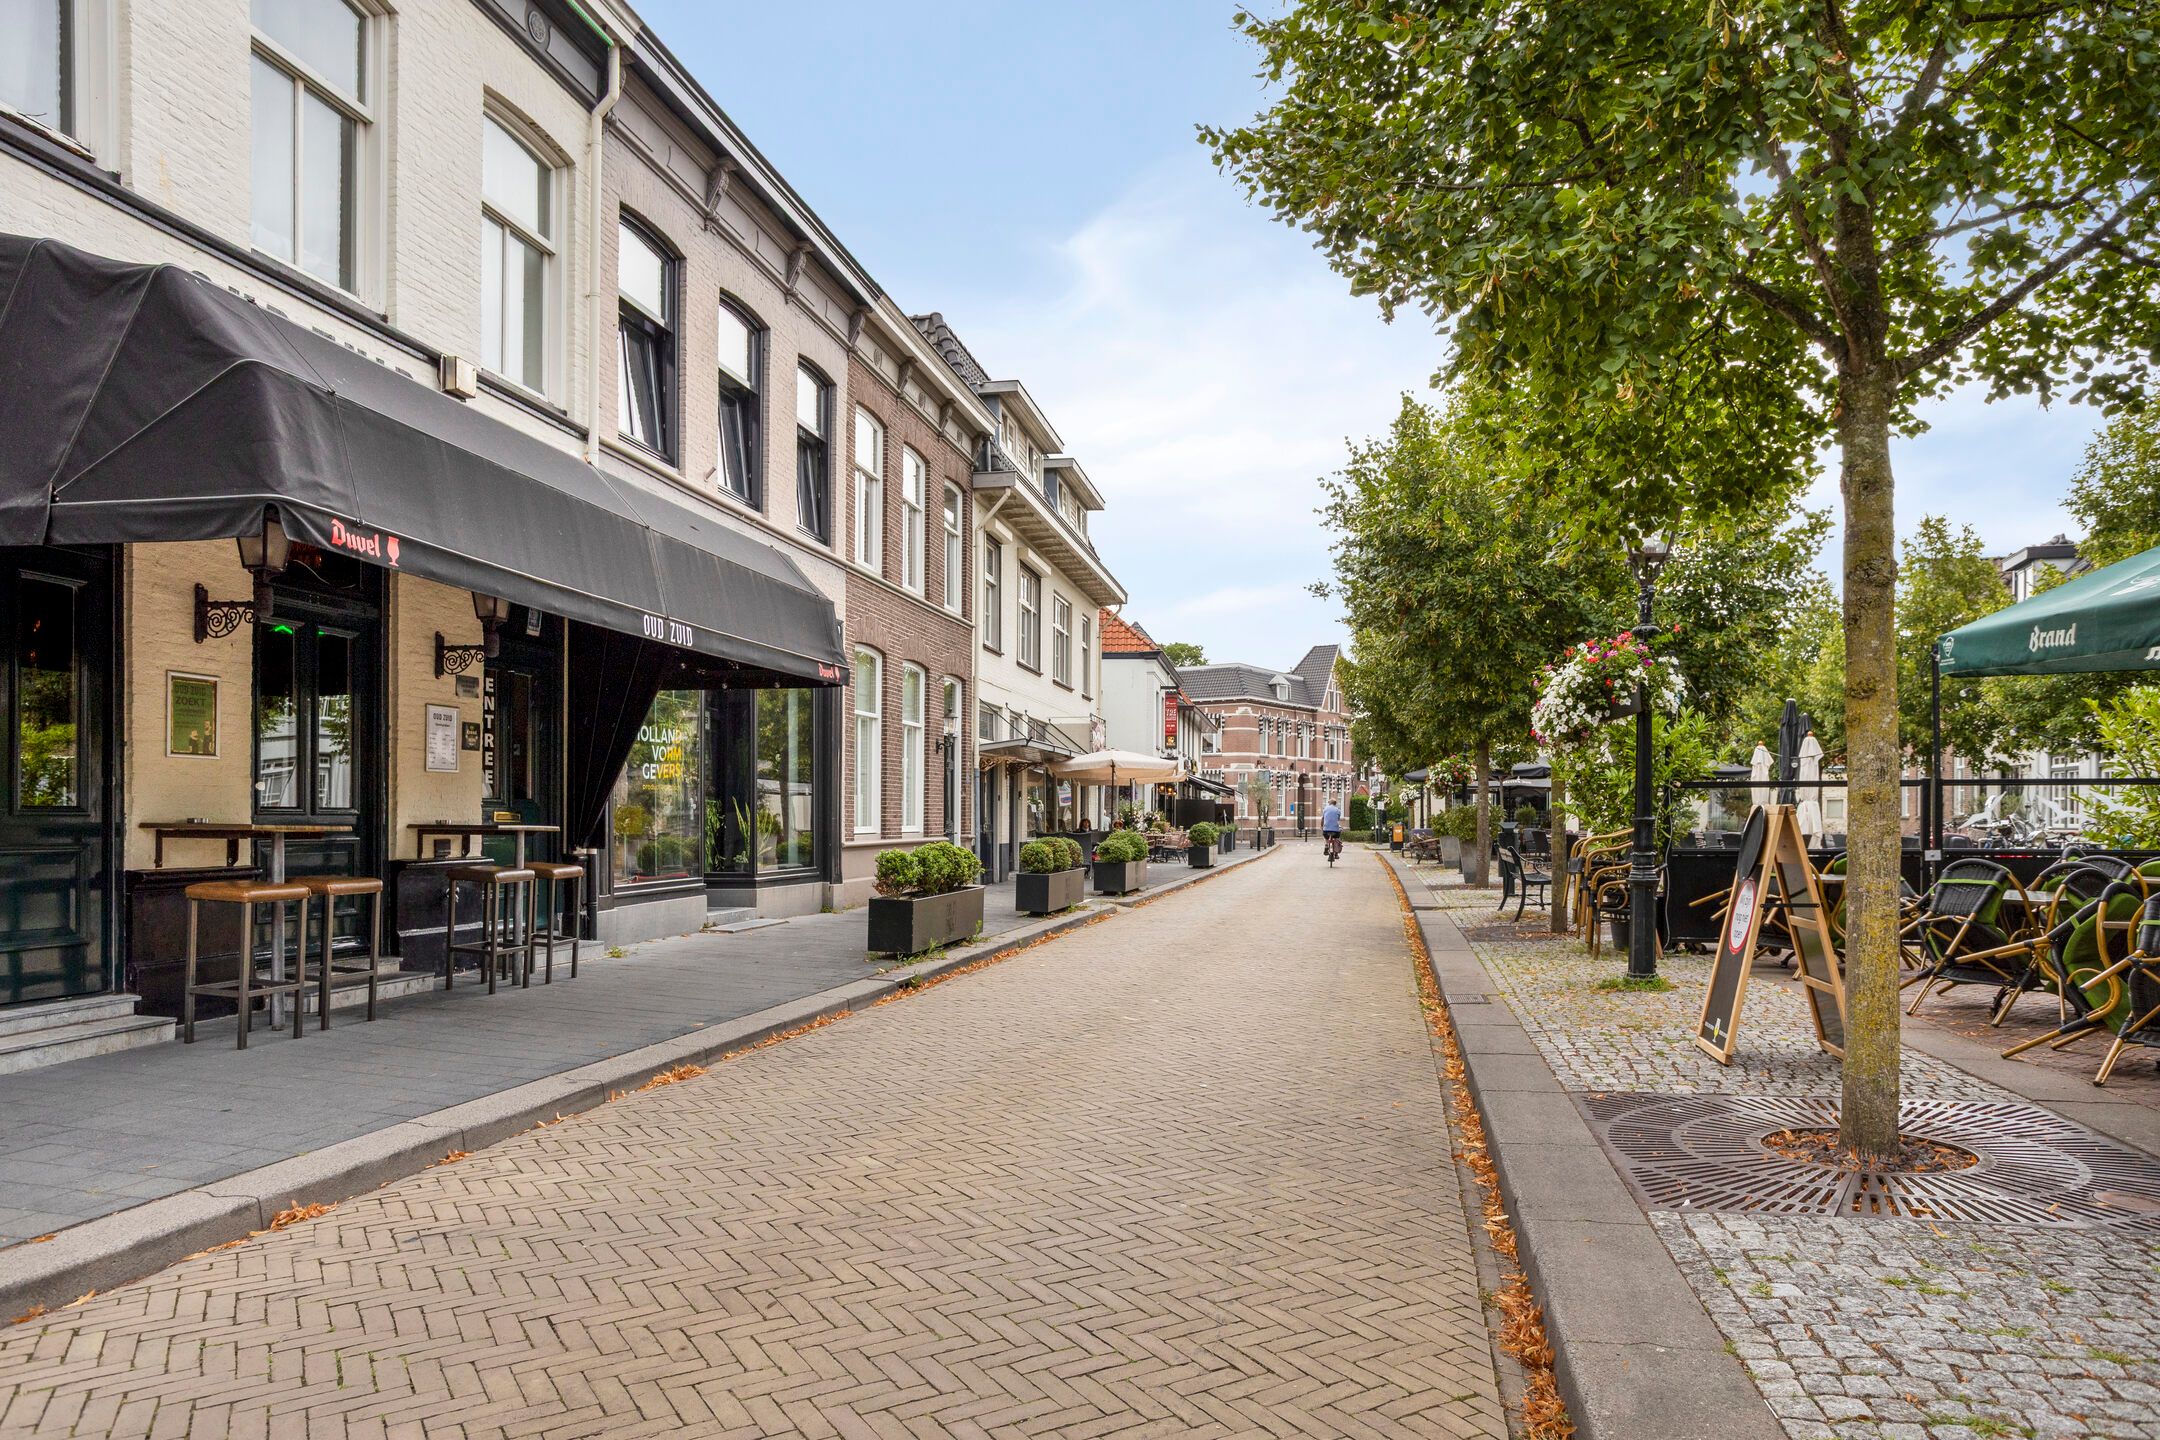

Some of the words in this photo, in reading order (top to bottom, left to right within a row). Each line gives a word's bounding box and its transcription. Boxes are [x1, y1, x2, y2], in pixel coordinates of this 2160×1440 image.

[331, 518, 381, 558] Duvel
[643, 614, 664, 640] OUD
[670, 621, 693, 647] ZUID
[2028, 622, 2077, 653] Brand
[175, 696, 207, 706] ZOEKT
[483, 677, 495, 784] ENTREE
[651, 744, 682, 762] VORM
[642, 762, 682, 780] GEVERS
